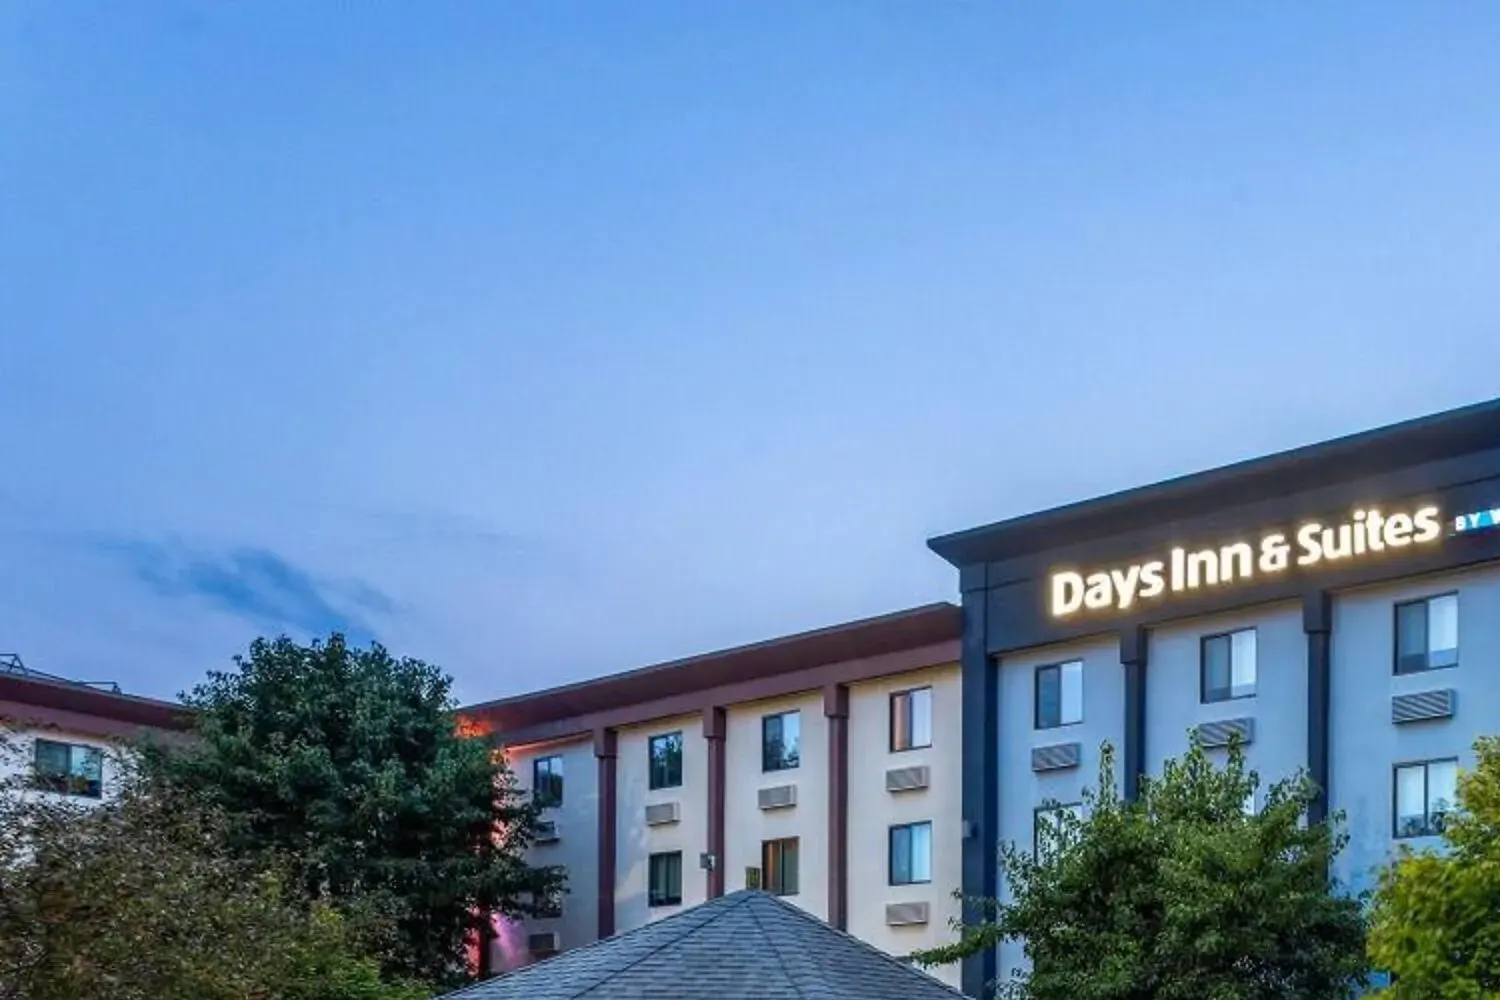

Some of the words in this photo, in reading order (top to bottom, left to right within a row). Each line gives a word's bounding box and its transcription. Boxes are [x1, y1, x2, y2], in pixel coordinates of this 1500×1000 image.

[1052, 560, 1165, 616] Days
[1171, 542, 1252, 591] Inn
[1258, 533, 1291, 572] &
[1297, 505, 1441, 564] Suites
[1455, 512, 1481, 532] BY
